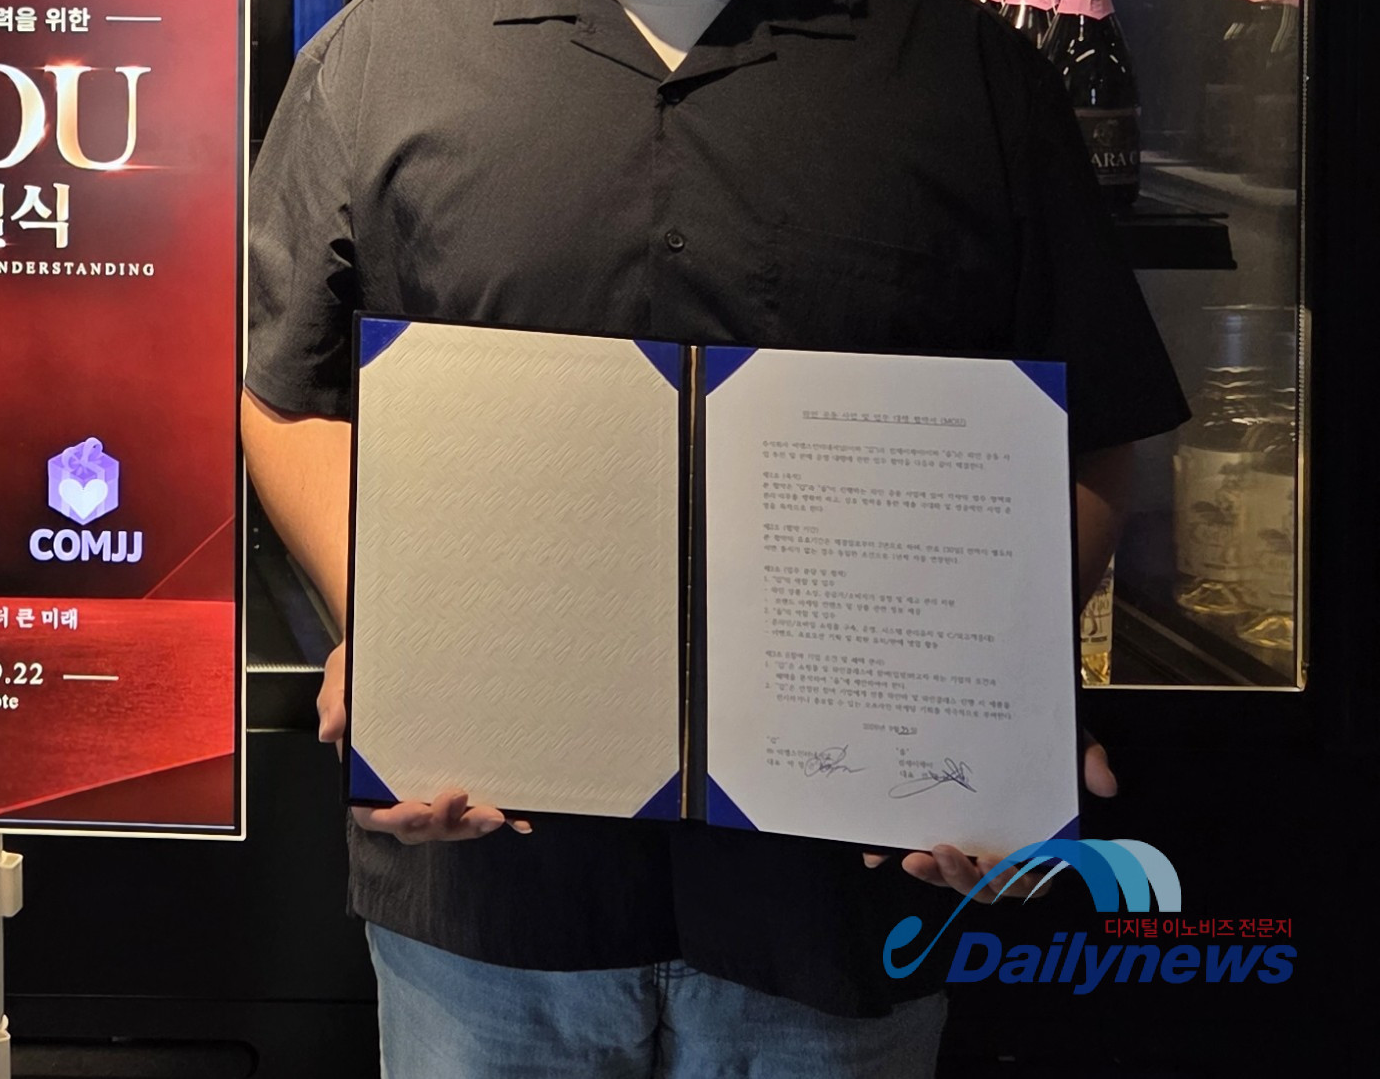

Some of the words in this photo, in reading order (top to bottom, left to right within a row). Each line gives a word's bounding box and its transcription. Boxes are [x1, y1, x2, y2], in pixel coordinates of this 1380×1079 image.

[45, 7, 91, 33] 위한
[29, 528, 143, 563] COMJJ
[15, 608, 36, 628] 큰
[41, 607, 79, 630] 미래
